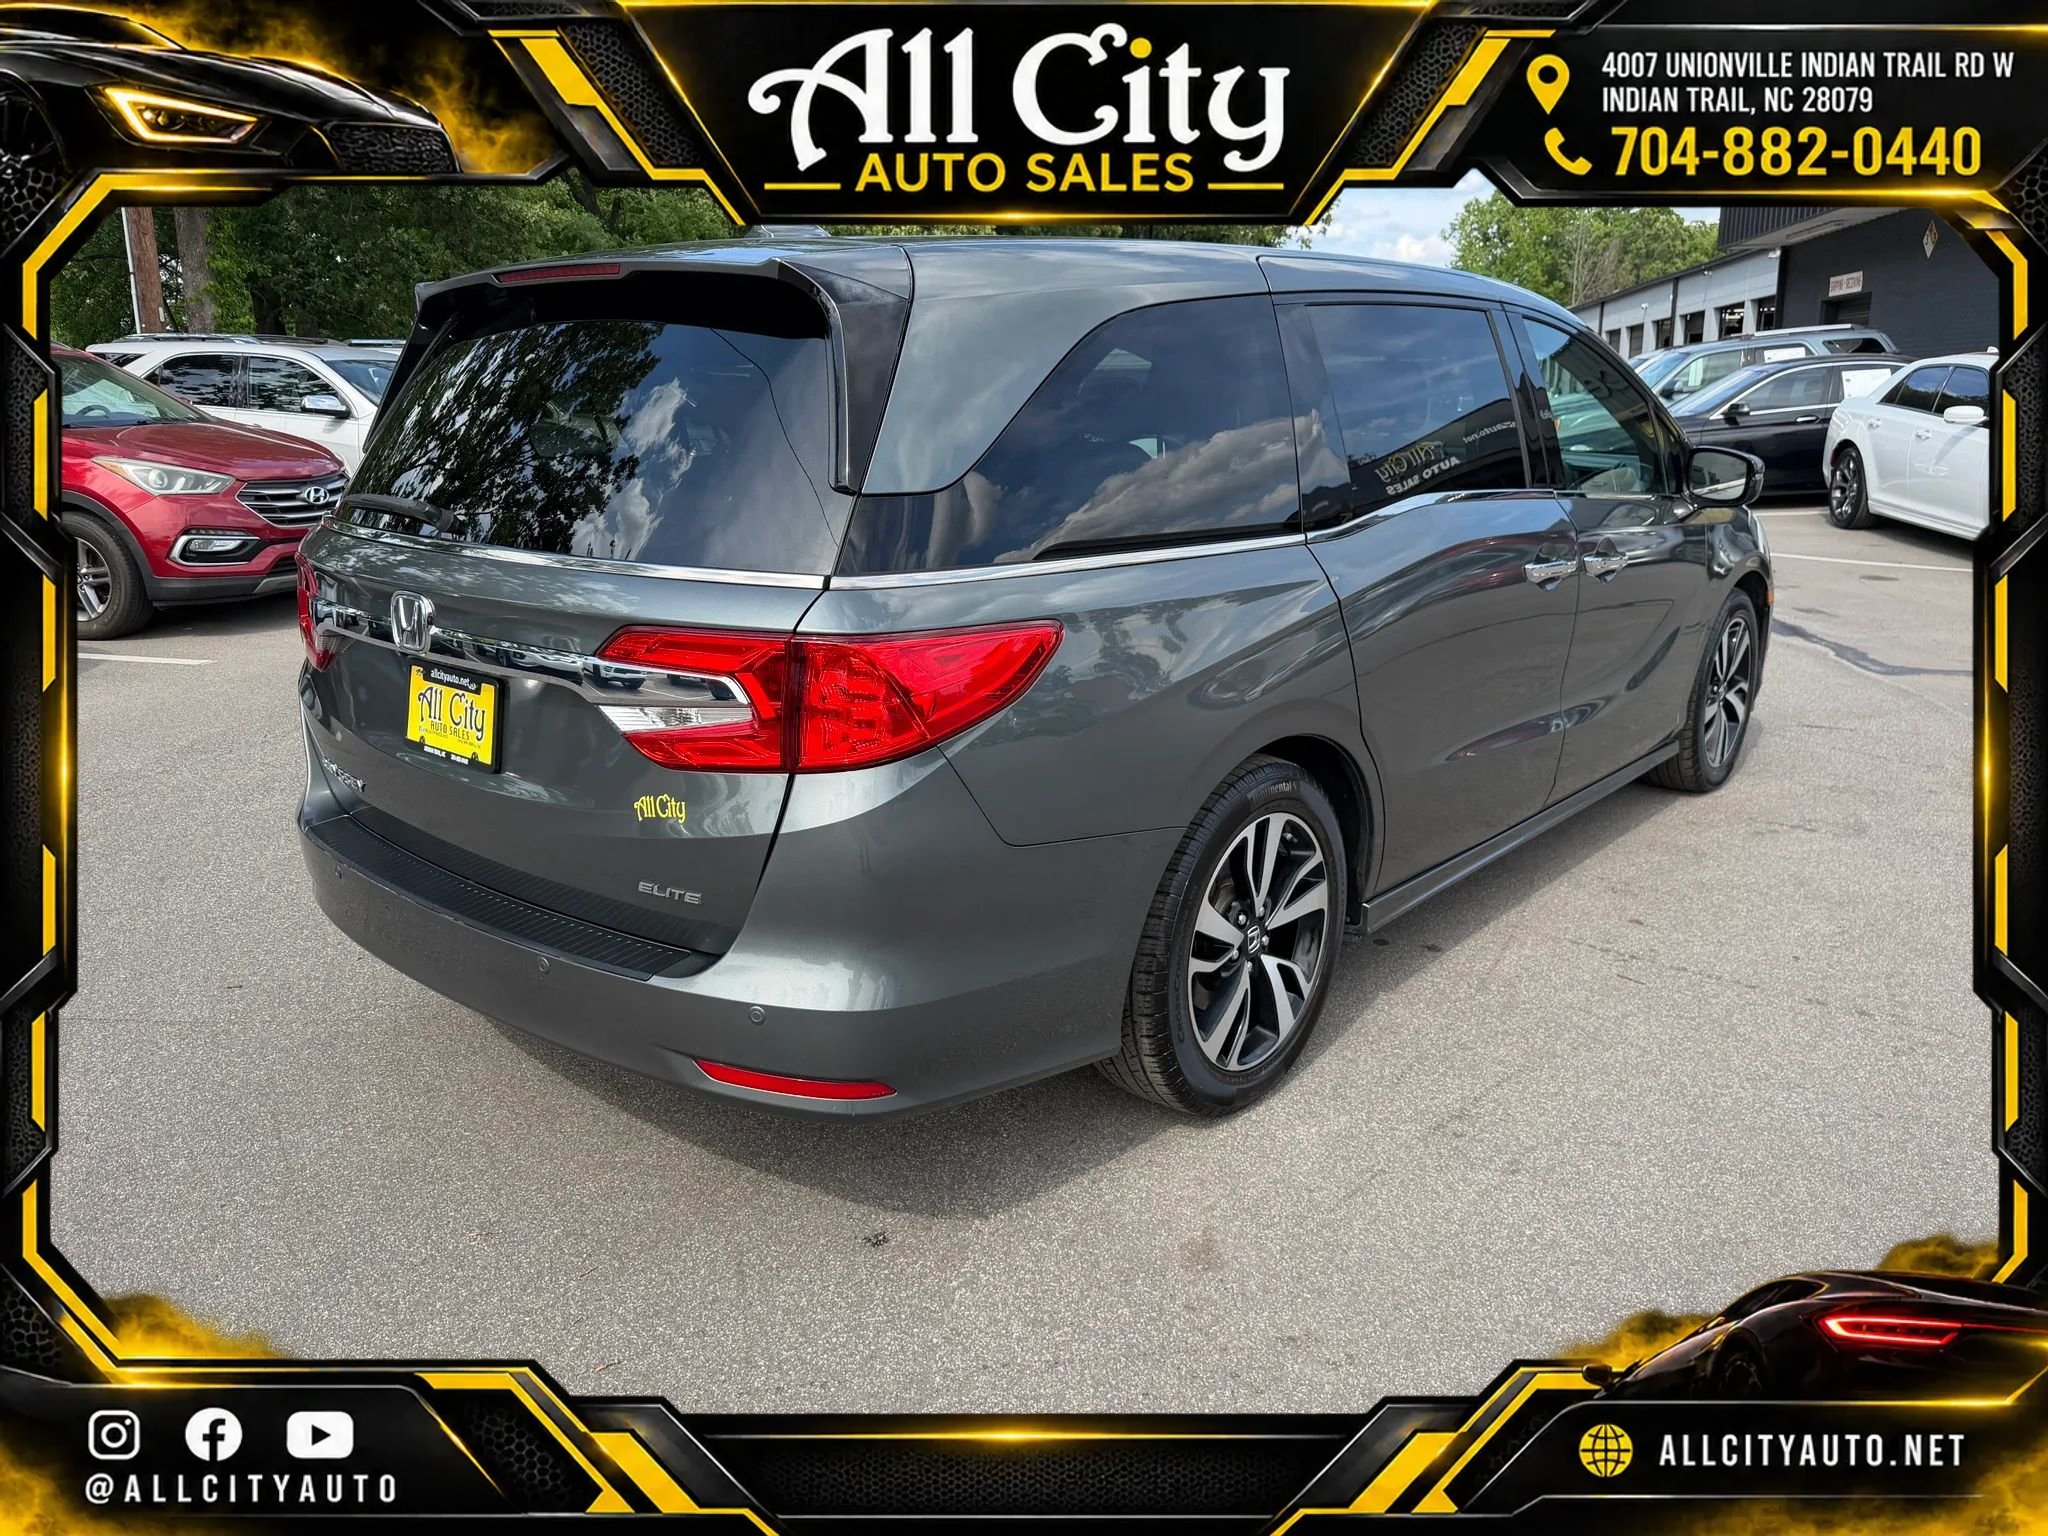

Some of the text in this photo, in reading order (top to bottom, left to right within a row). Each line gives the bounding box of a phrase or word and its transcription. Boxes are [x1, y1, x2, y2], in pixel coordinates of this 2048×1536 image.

[430, 668, 470, 686] allcityauto.net
[418, 687, 486, 741] All City
[430, 721, 448, 735] AUTO
[449, 725, 470, 741] SALES
[634, 793, 686, 824] All City
[638, 881, 702, 905] ELITE
